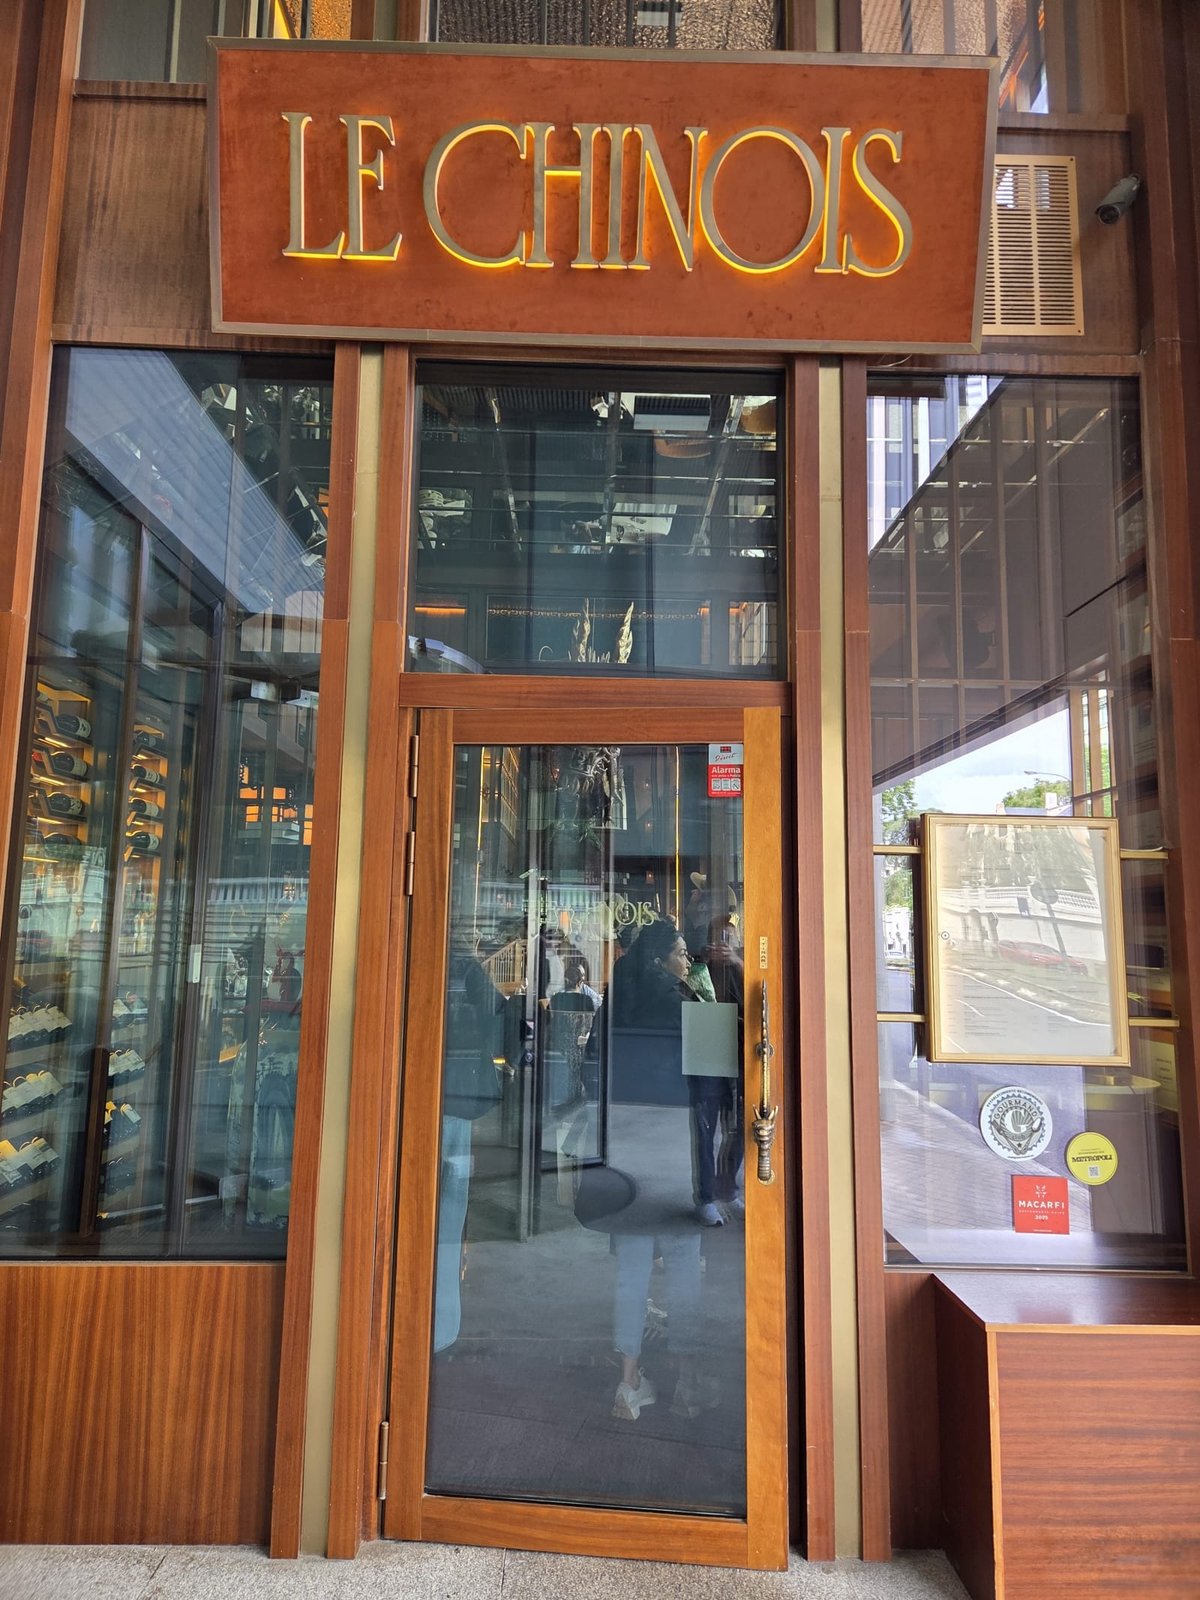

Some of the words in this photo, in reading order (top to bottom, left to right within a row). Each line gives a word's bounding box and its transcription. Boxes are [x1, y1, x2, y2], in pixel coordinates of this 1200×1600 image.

[281, 111, 402, 261] LE
[423, 120, 913, 277] CHINOIS
[711, 766, 741, 774] Alarma
[994, 1099, 1038, 1120] GOURMAND
[1071, 1154, 1113, 1163] METROPOLI
[1018, 1200, 1065, 1209] MACARFI
